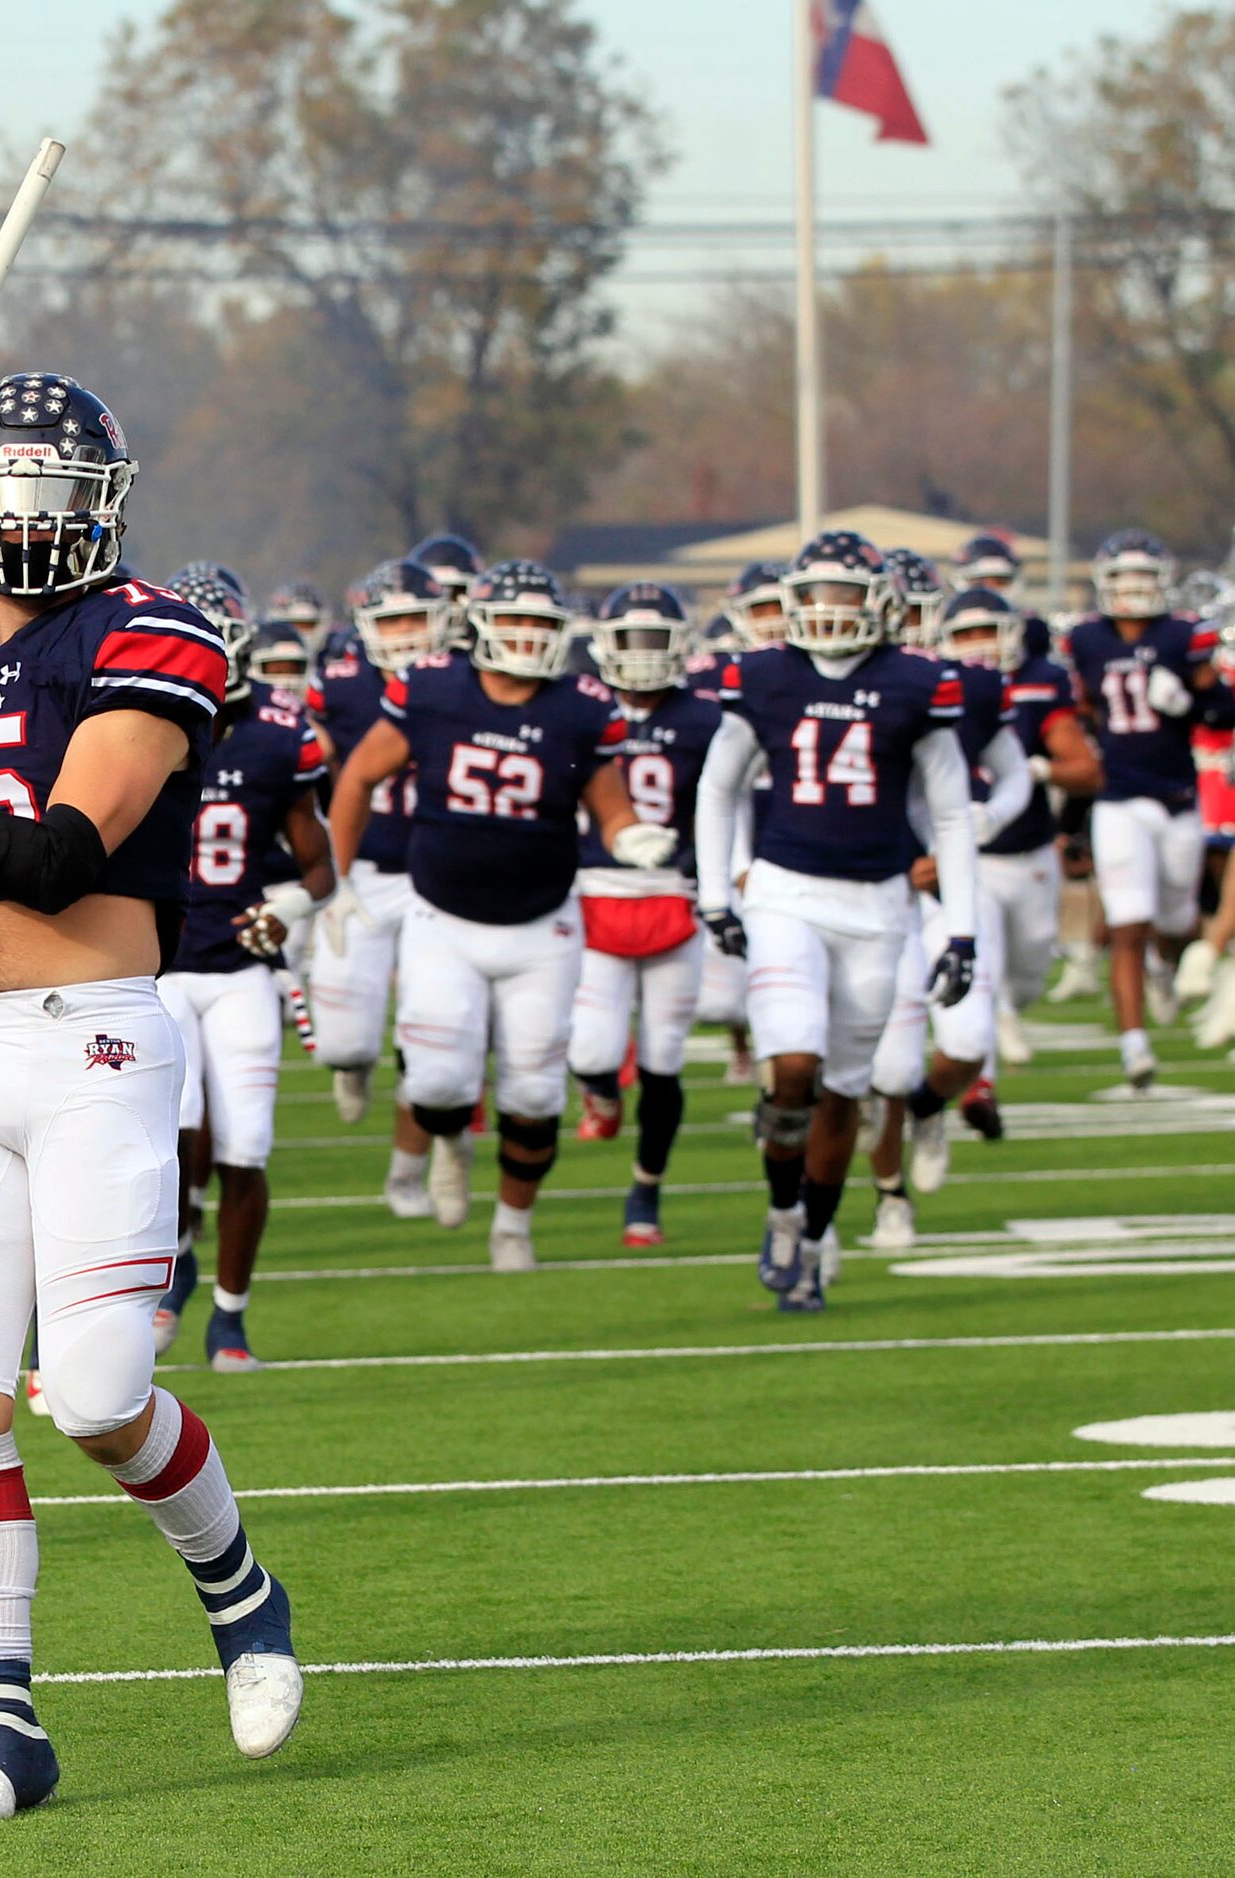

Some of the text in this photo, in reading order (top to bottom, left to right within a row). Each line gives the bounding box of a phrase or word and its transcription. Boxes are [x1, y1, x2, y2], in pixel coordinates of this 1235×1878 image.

[3, 447, 51, 458] Riddell
[1101, 672, 1161, 734] 11
[446, 743, 544, 821] 52
[792, 717, 877, 806] 14
[88, 1042, 133, 1055] RYAN
